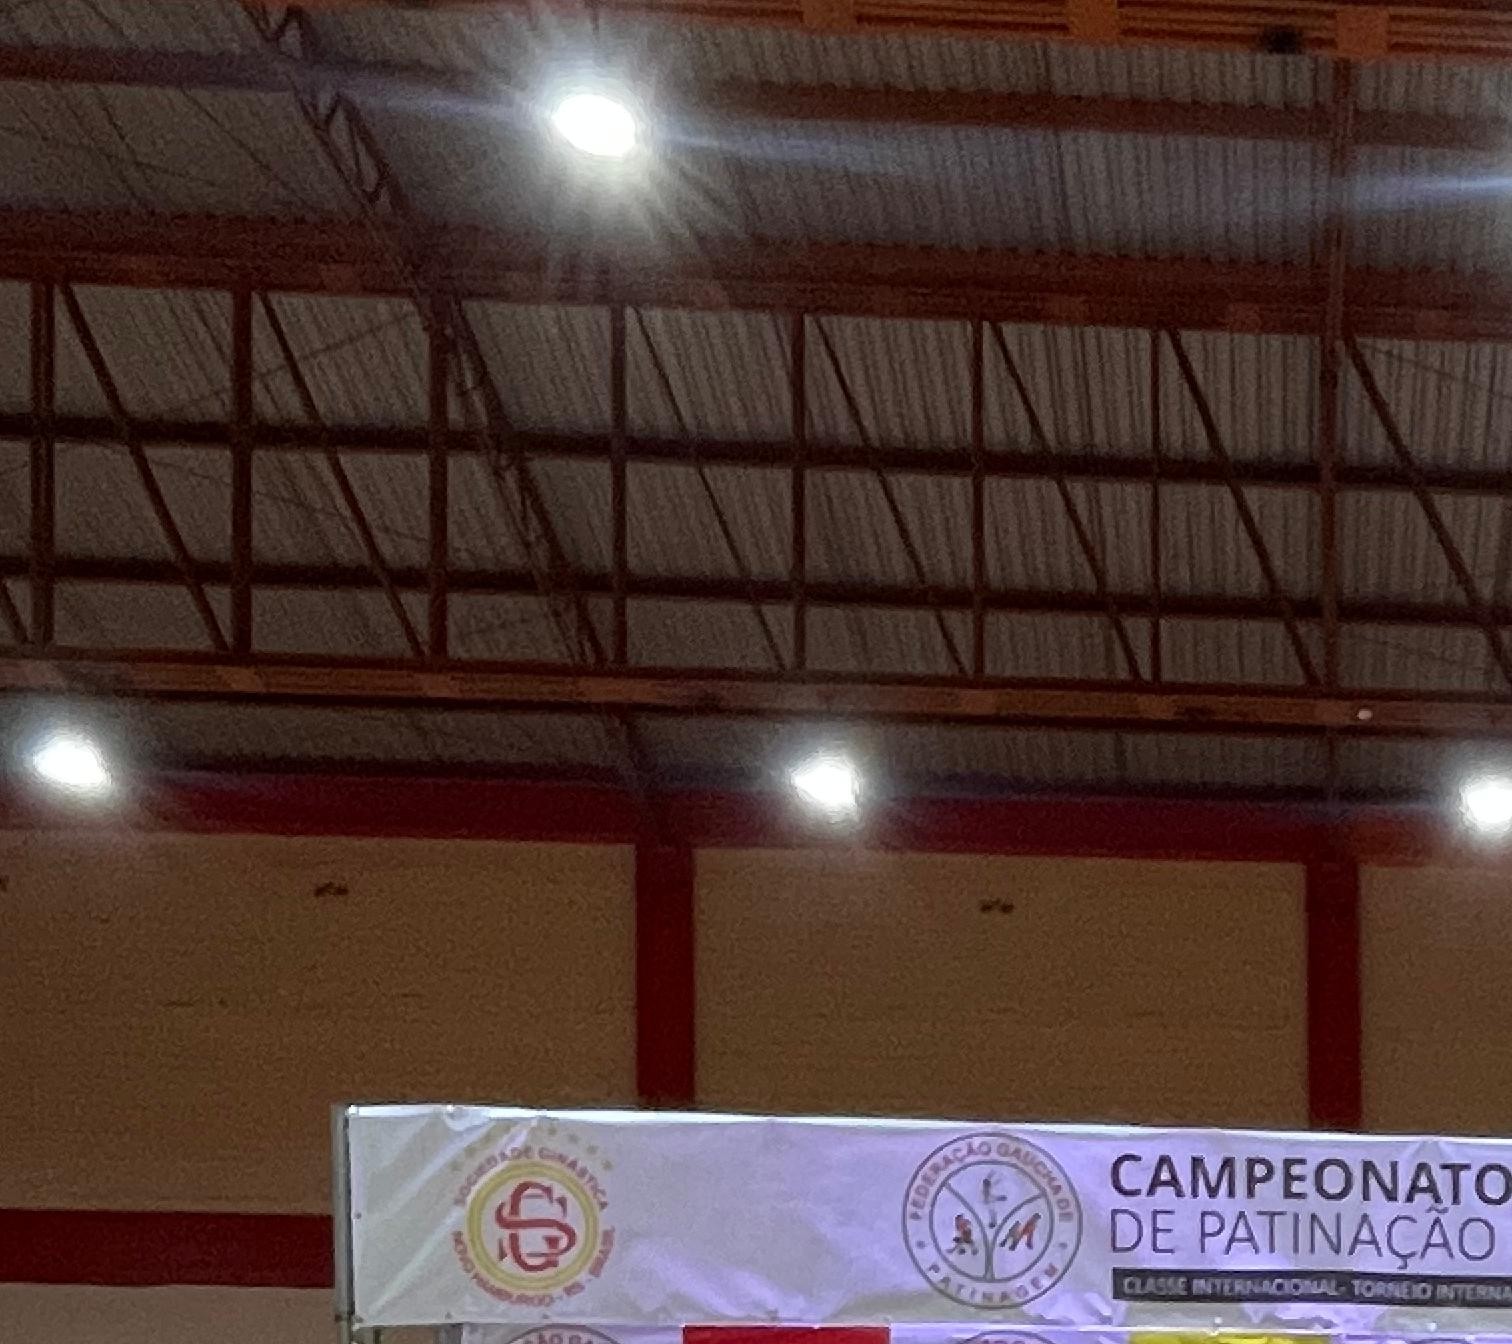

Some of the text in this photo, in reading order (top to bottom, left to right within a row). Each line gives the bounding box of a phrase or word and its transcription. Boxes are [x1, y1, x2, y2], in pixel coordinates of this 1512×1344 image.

[909, 1140, 992, 1220] FEDERAÇÃO
[1110, 1208, 1176, 1254] DE
[1200, 1205, 1496, 1270] PATINAÇÃO
[928, 1262, 1058, 1302] PATINAGEM
[1122, 1276, 1189, 1295] CLASSE
[1351, 1280, 1433, 1300] TORNEIO
